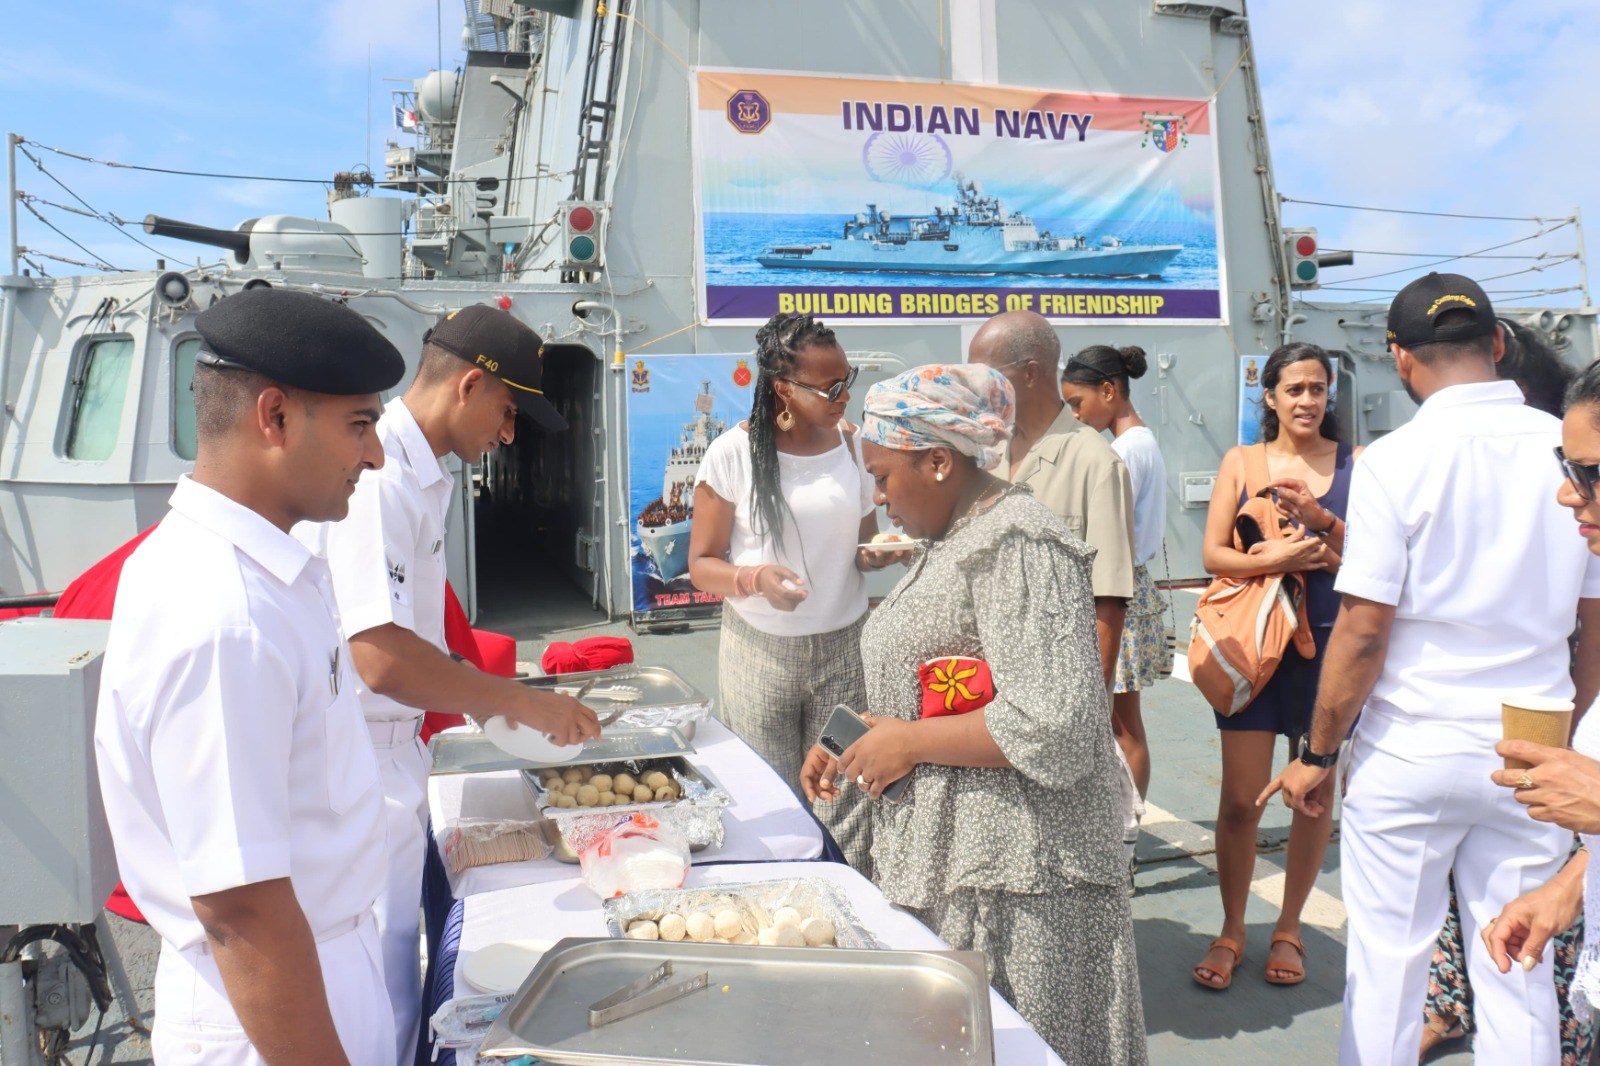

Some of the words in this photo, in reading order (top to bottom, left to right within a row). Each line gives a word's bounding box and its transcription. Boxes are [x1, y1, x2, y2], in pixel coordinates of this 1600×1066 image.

[841, 100, 981, 136] INDIAN
[994, 109, 1094, 142] NAVY
[778, 293, 893, 314] BUILDING
[900, 293, 1000, 315] BRIDGES
[1005, 294, 1034, 313] OF
[1039, 294, 1165, 315] FRIENDSHIP
[655, 593, 690, 606] TEAM
